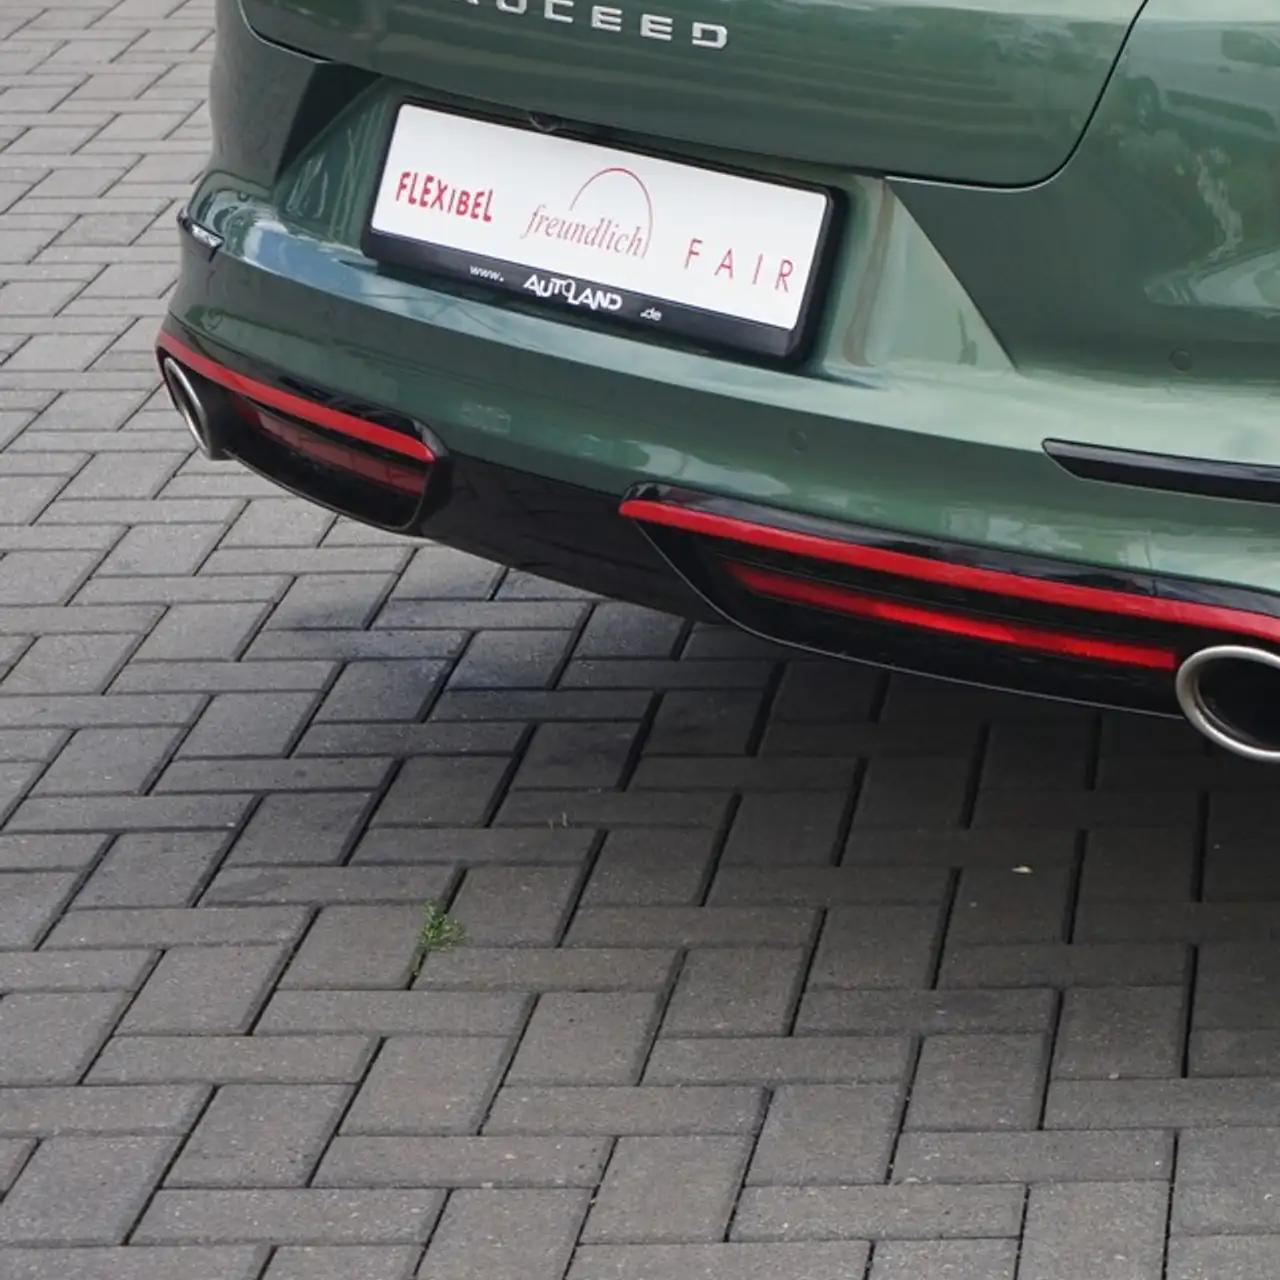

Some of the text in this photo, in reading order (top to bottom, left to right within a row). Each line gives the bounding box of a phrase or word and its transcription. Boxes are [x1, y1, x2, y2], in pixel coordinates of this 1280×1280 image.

[395, 171, 493, 223] FLEXIBEL
[519, 204, 644, 257] freundlich
[684, 238, 795, 294] FAIR
[469, 265, 663, 322] www. AUTOLAND .de
